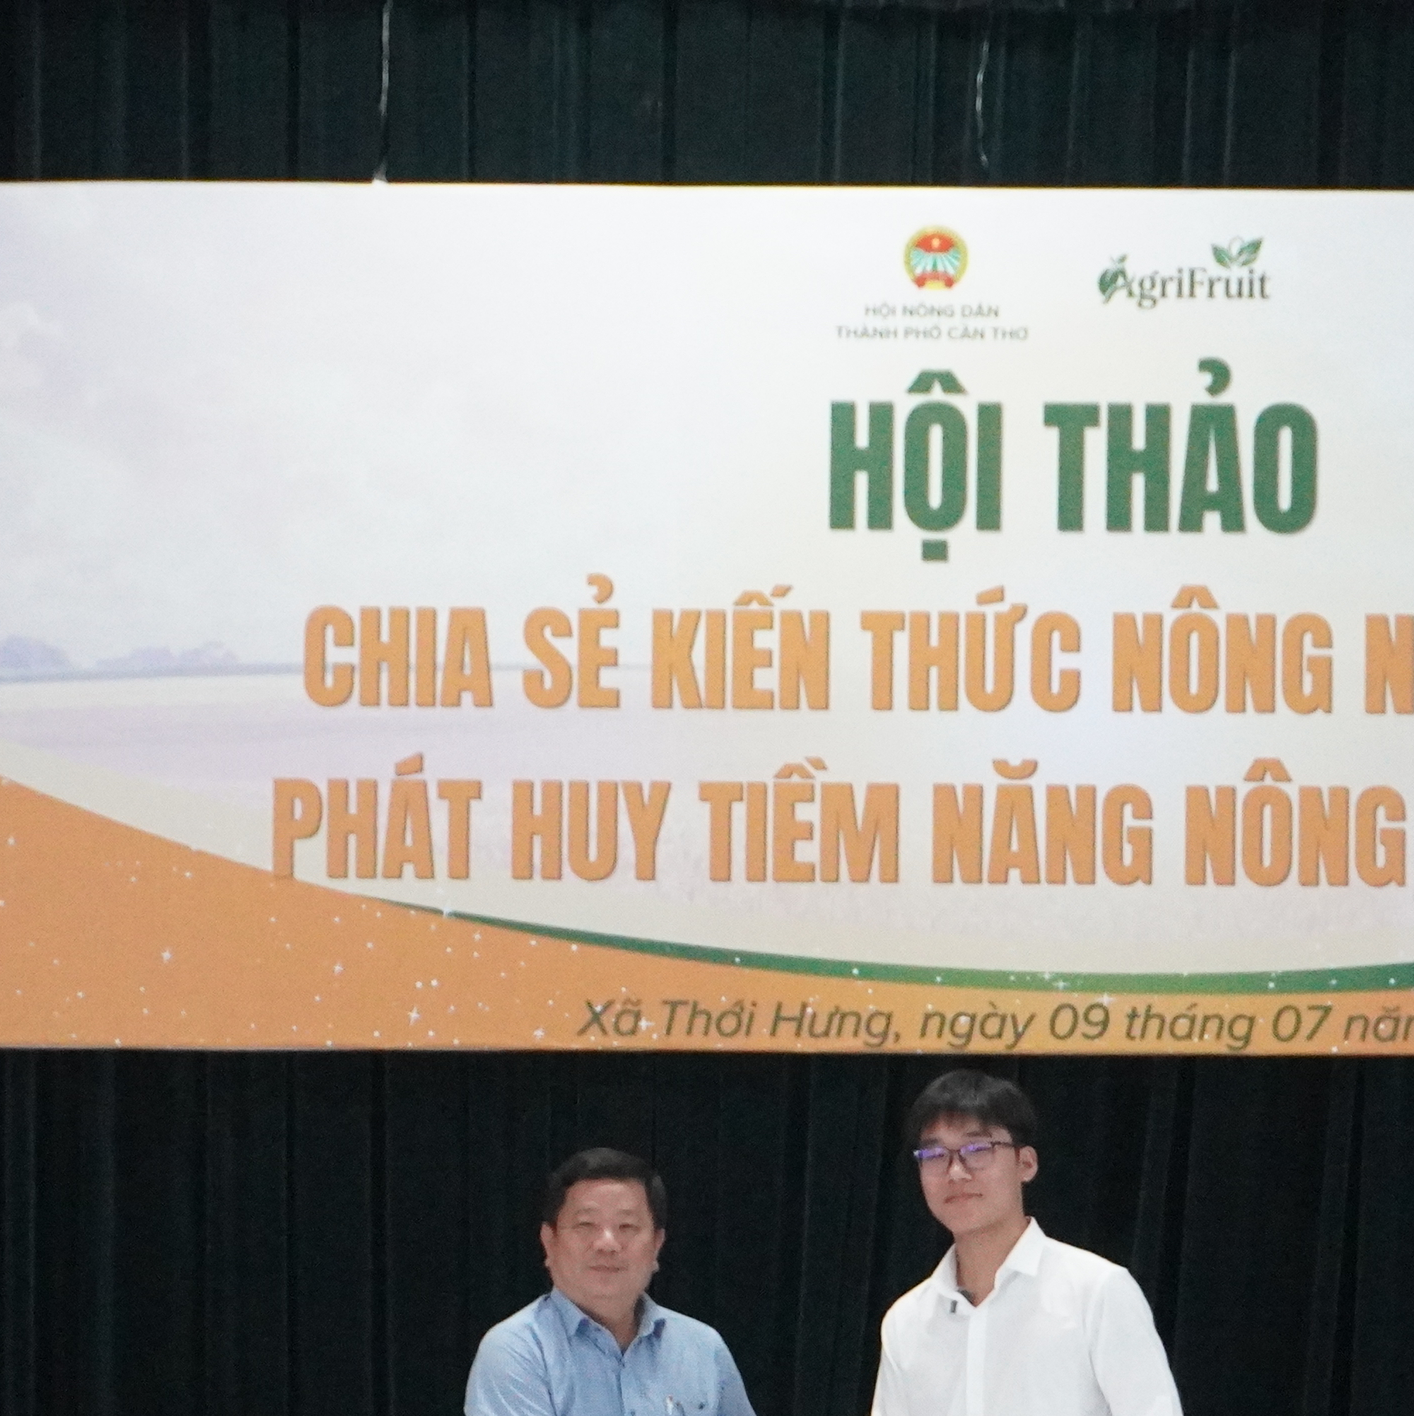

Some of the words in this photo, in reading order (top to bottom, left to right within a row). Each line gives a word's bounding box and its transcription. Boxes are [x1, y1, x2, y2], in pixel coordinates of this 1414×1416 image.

[902, 301, 955, 317] NÔNG
[961, 302, 999, 317] DÂN
[1098, 262, 1270, 309] AgriFruit
[837, 324, 898, 339] THÀNH
[829, 369, 1003, 562] HỘI
[1043, 358, 1319, 534] THẢO
[304, 606, 493, 707] CHIA
[523, 574, 620, 708] SẺ
[651, 584, 829, 711] KIẾN
[861, 586, 1082, 713] THỨC
[1112, 585, 1334, 714] NÔNG
[272, 752, 482, 880] PHÁT
[511, 780, 672, 881] HUY
[698, 756, 900, 883] TIỀM
[932, 758, 1154, 886] NĂNG
[1186, 758, 1407, 888] NÔNG
[576, 998, 642, 1037] Xã
[661, 1000, 758, 1037] Thới
[769, 1001, 902, 1049] Hưng,
[919, 1001, 1037, 1049] ngày
[1049, 1003, 1111, 1041] 09
[1126, 1003, 1257, 1050] tháng
[1272, 1004, 1333, 1042] 07
